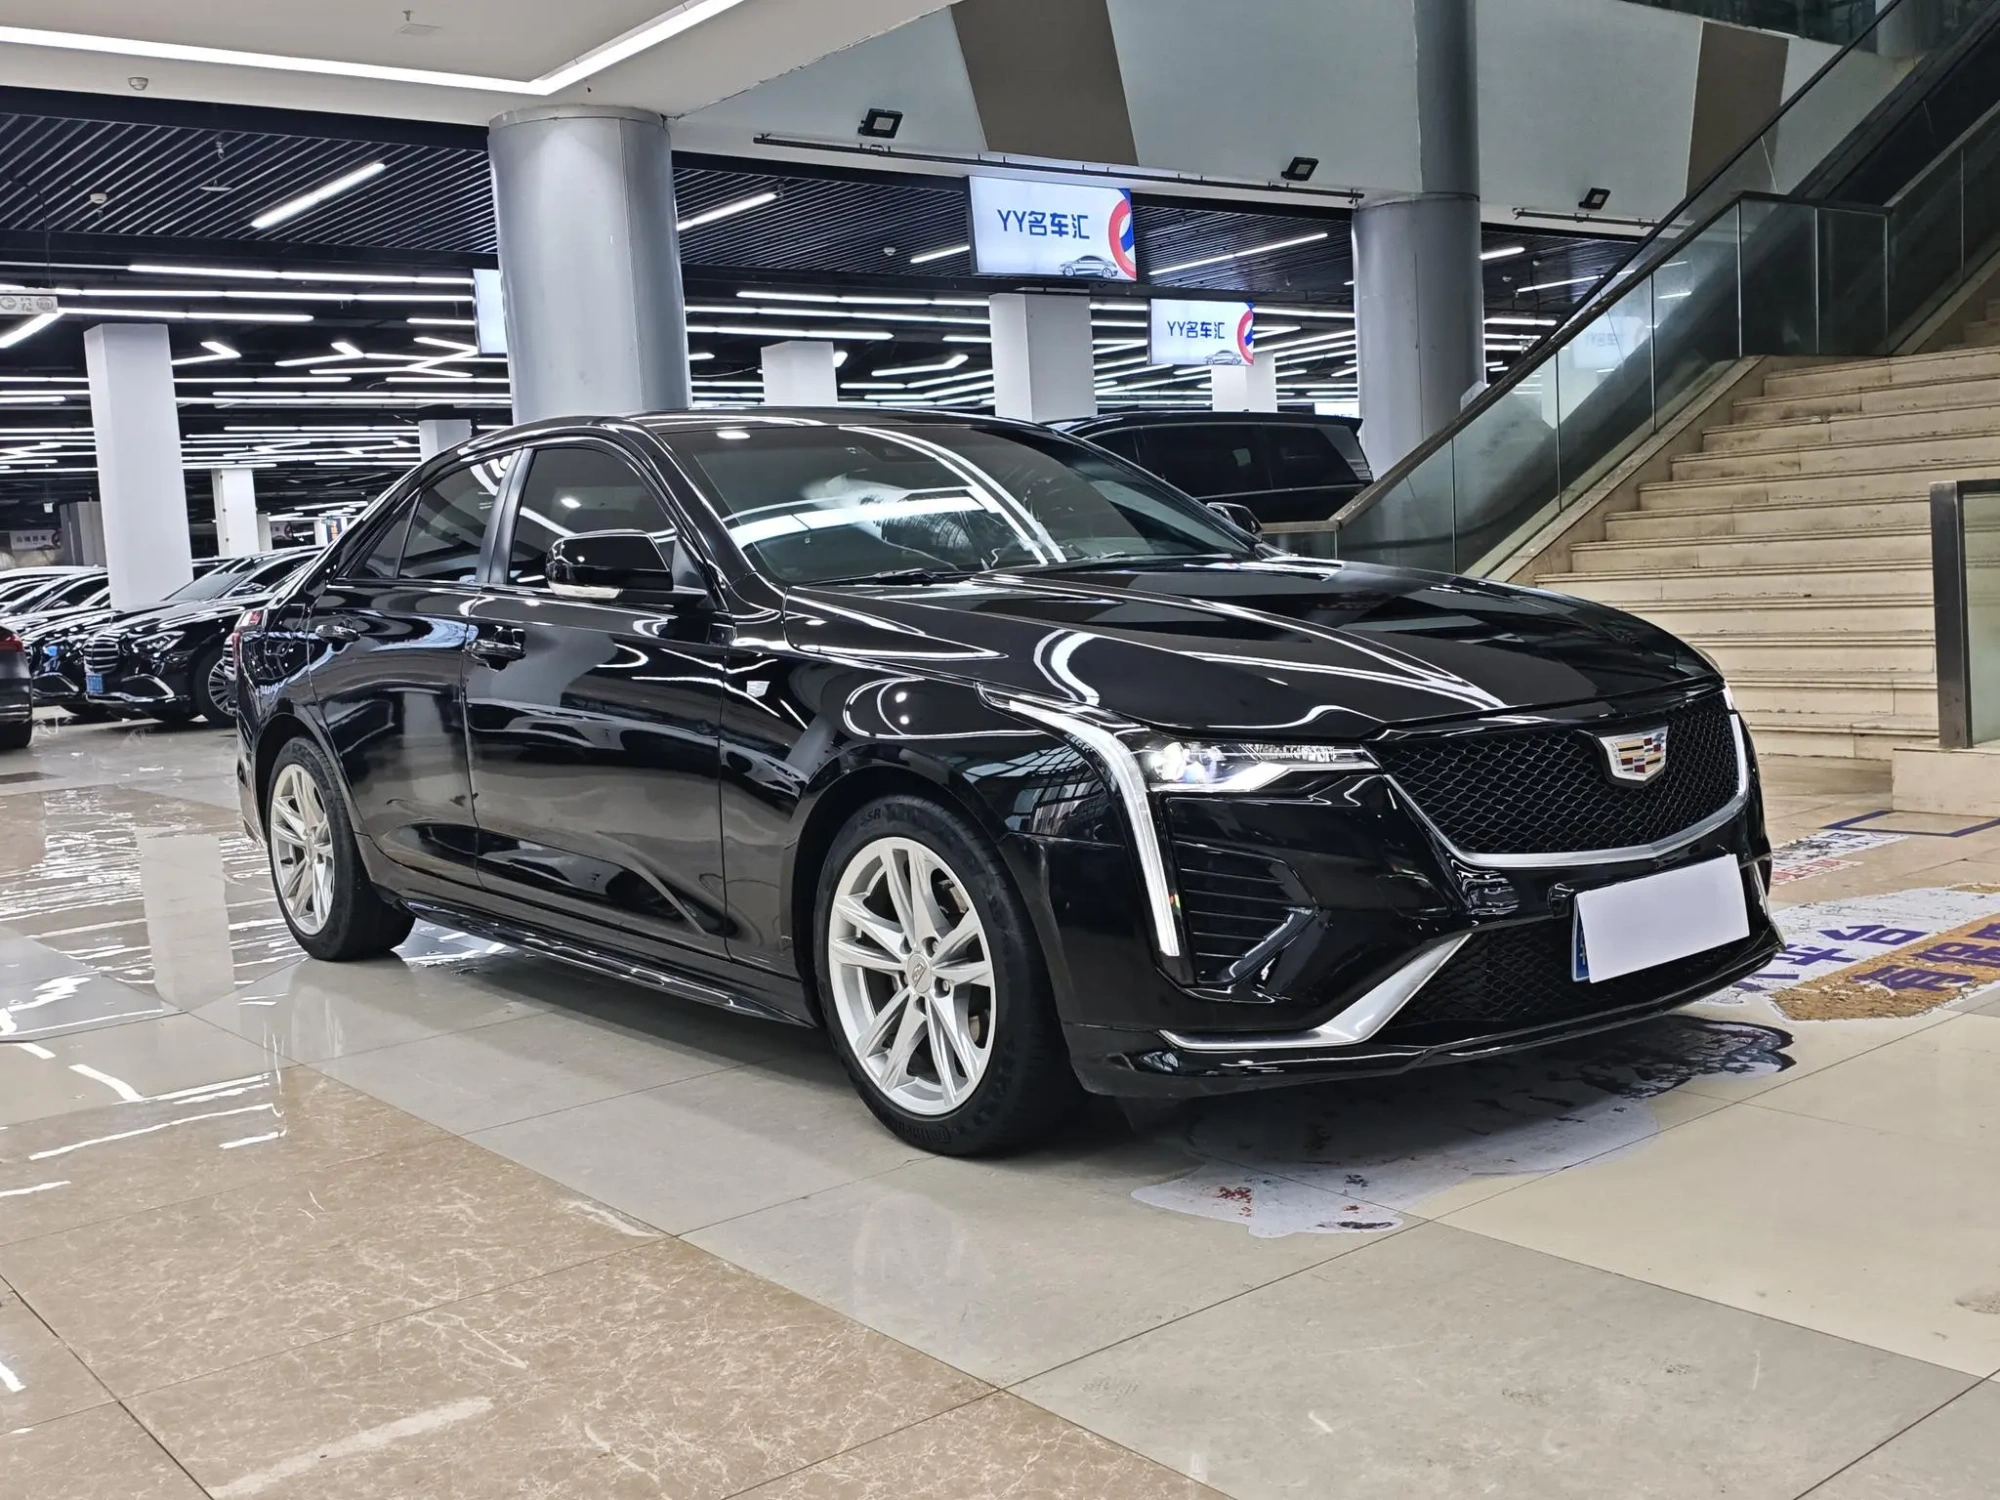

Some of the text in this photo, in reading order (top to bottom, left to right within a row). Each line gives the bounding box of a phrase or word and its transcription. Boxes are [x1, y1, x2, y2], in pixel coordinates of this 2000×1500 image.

[997, 209, 1091, 240] YY名车汇
[1166, 320, 1226, 340] YY名车汇
